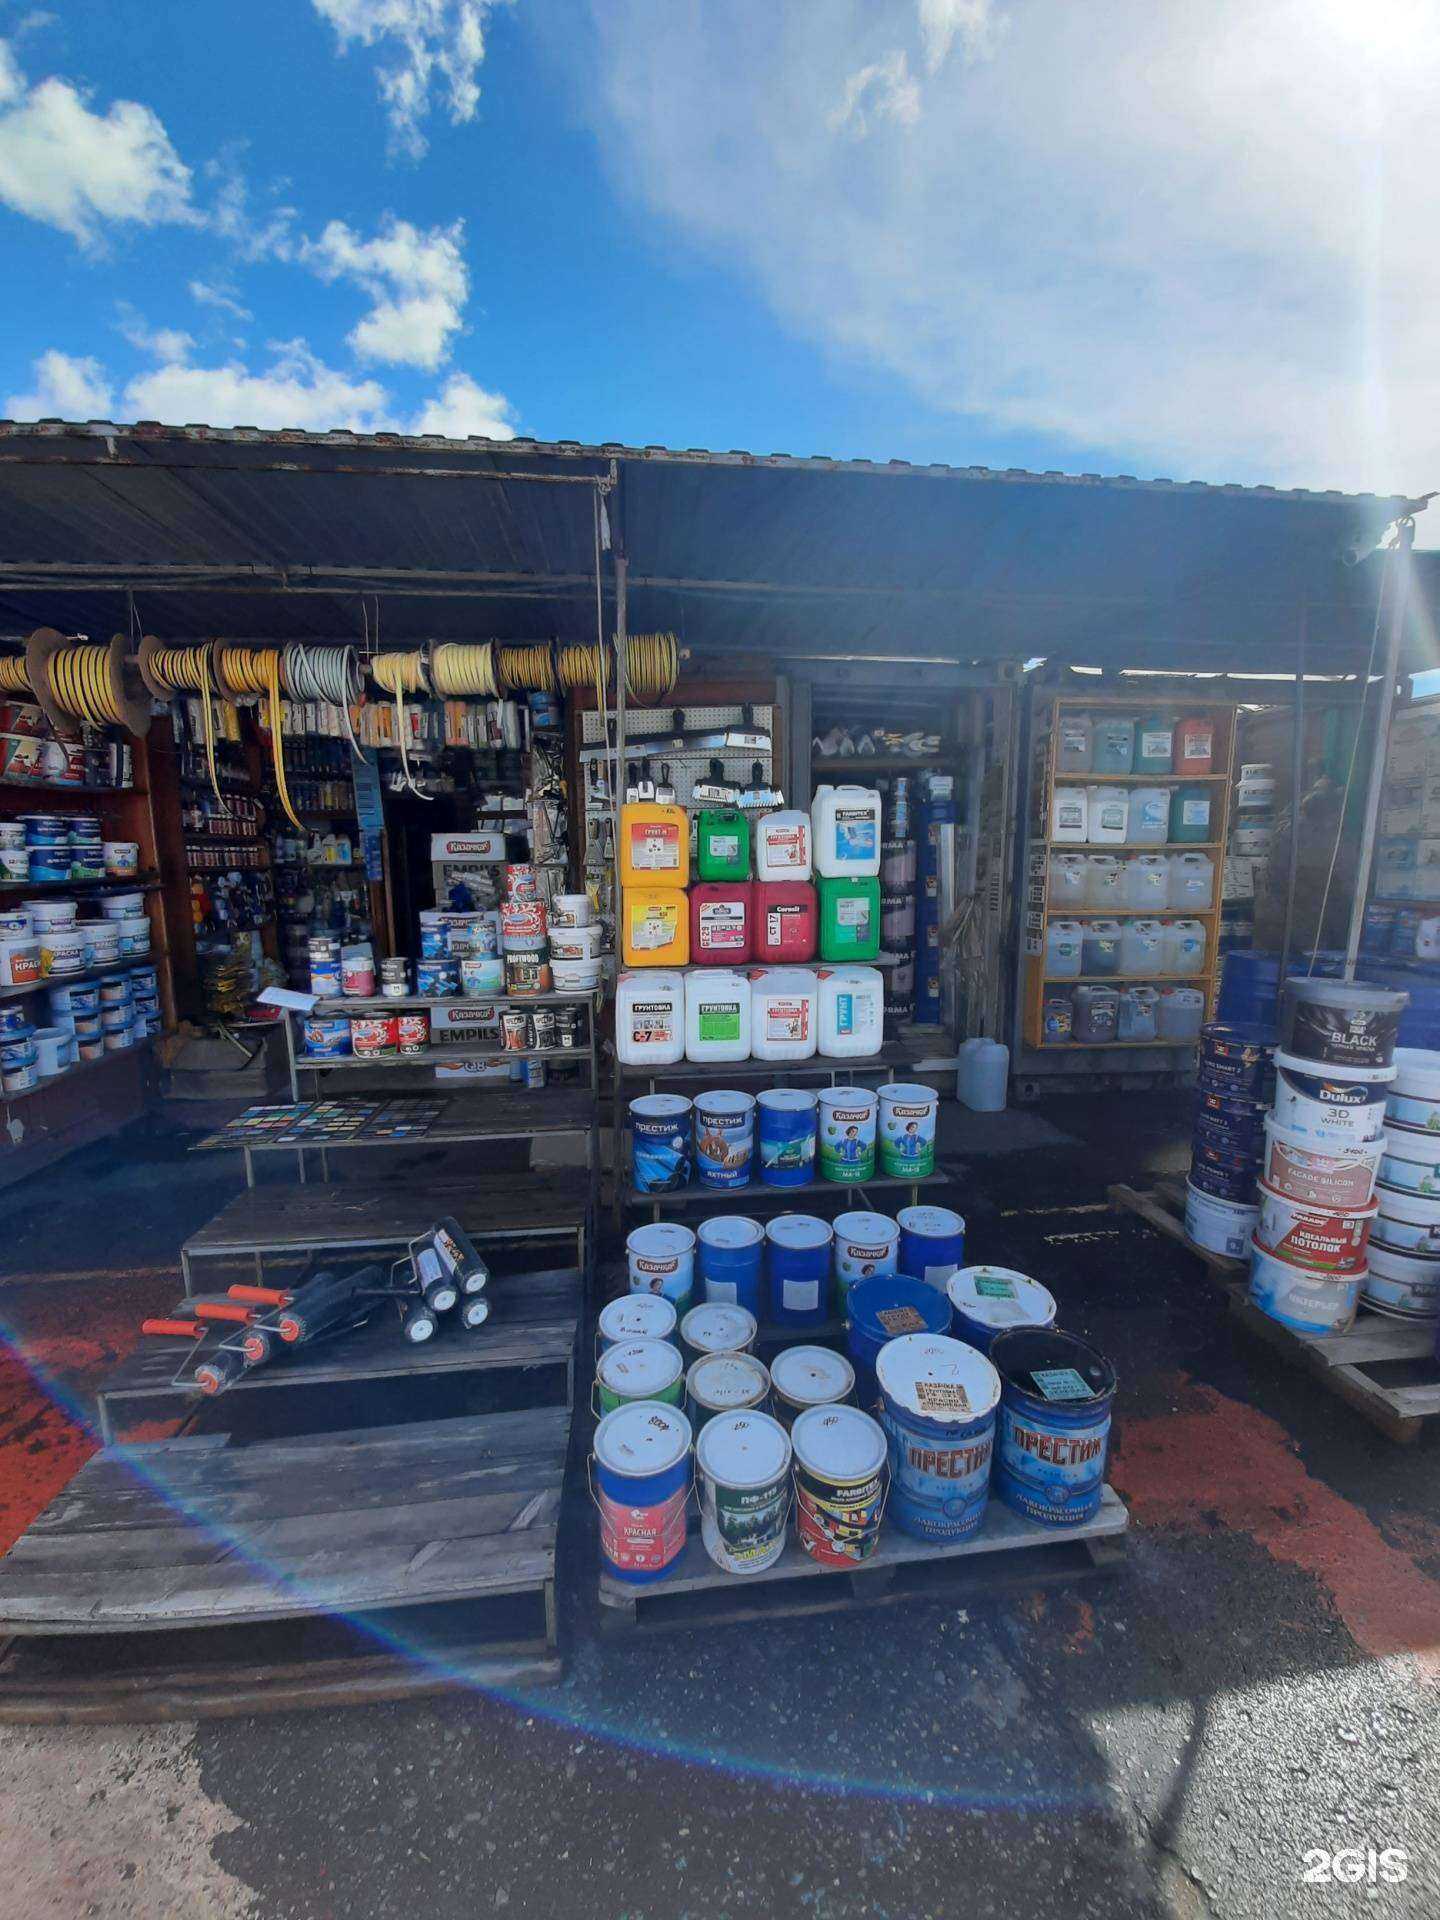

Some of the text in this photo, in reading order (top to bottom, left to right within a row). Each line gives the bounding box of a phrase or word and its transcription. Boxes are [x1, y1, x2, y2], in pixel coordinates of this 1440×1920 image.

[634, 1003, 671, 1011] ГРУНТОВКА
[701, 1004, 737, 1013] ГРУНТОВКА
[440, 1028, 499, 1041] EMPILS
[1331, 1032, 1377, 1046] BLACK
[1319, 1088, 1362, 1104] Dulux
[1327, 1108, 1350, 1119] 3D
[703, 1116, 743, 1126] ПРЕСТИЖ
[1321, 1118, 1355, 1127] WHITE
[635, 1122, 679, 1132] ПРЕСТИЖ
[707, 1170, 738, 1179] ЯХТНЫЙ
[1299, 1230, 1347, 1244] ИДЕАЛЬНЫЙ
[1291, 1235, 1342, 1253] ПОТОЛОК
[740, 1487, 777, 1504] ПФ-115
[624, 1526, 657, 1536] КРАСНАЯ
